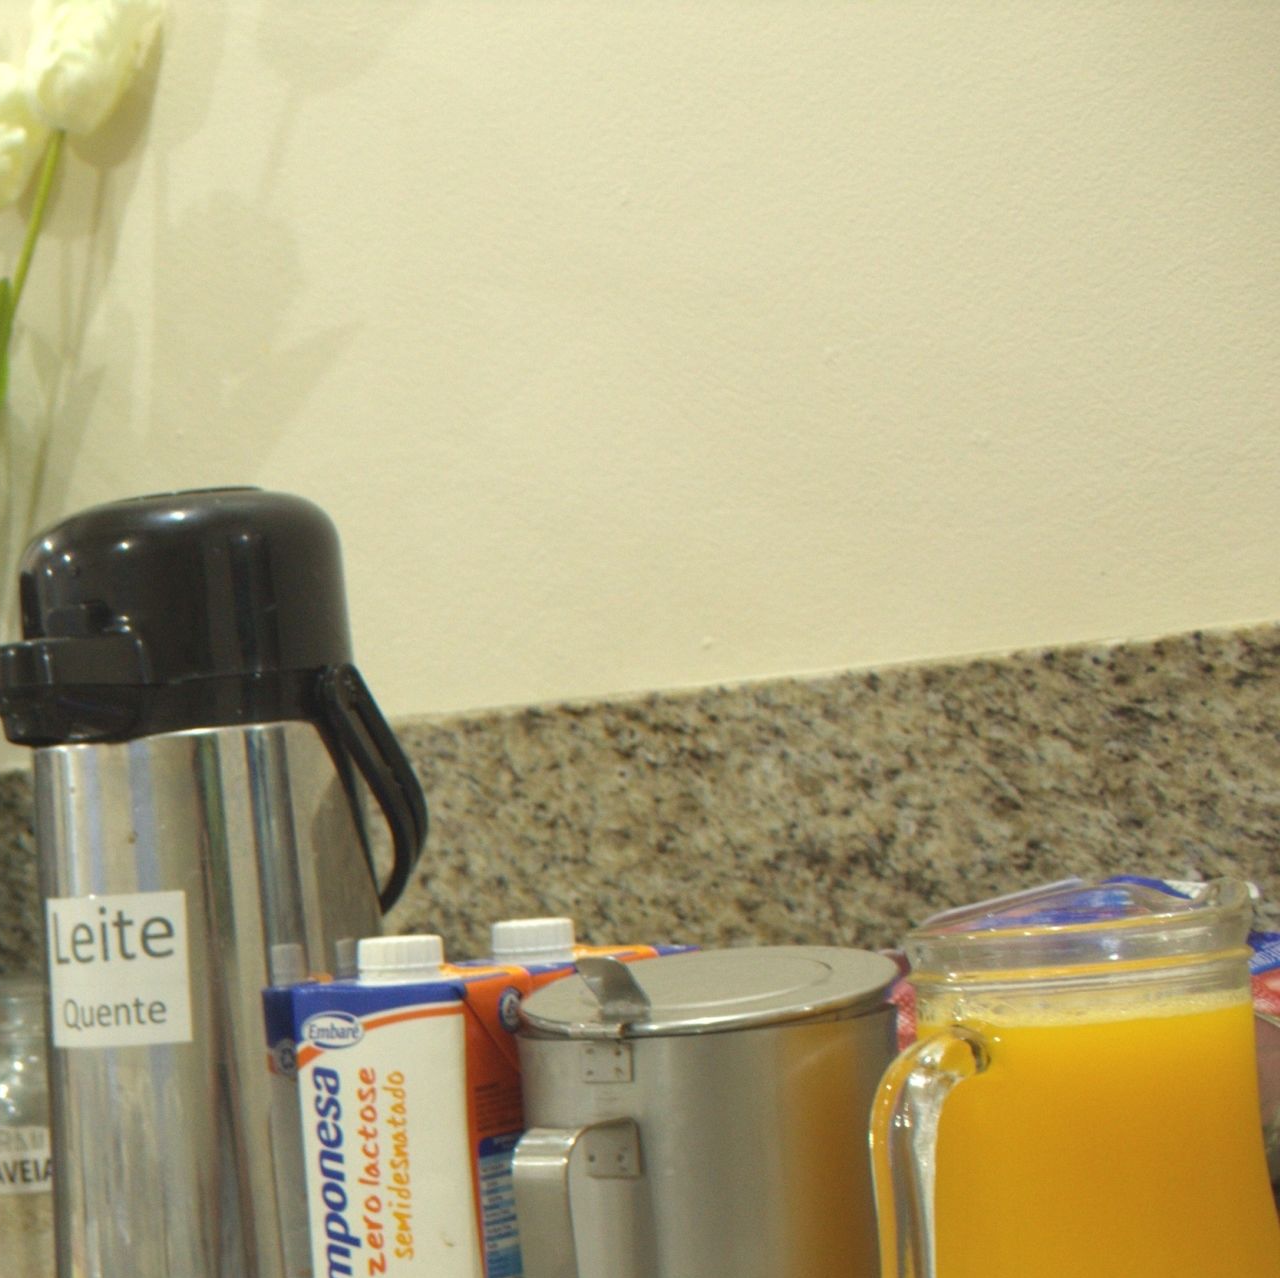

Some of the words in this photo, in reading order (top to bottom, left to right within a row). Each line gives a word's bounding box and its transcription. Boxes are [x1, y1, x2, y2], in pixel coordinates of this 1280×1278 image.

[53, 905, 175, 965] Leite
[63, 997, 167, 1031] Quente
[357, 1067, 381, 1186] lactose
[382, 1071, 415, 1260] semidesnatado
[363, 1194, 387, 1276] zero
